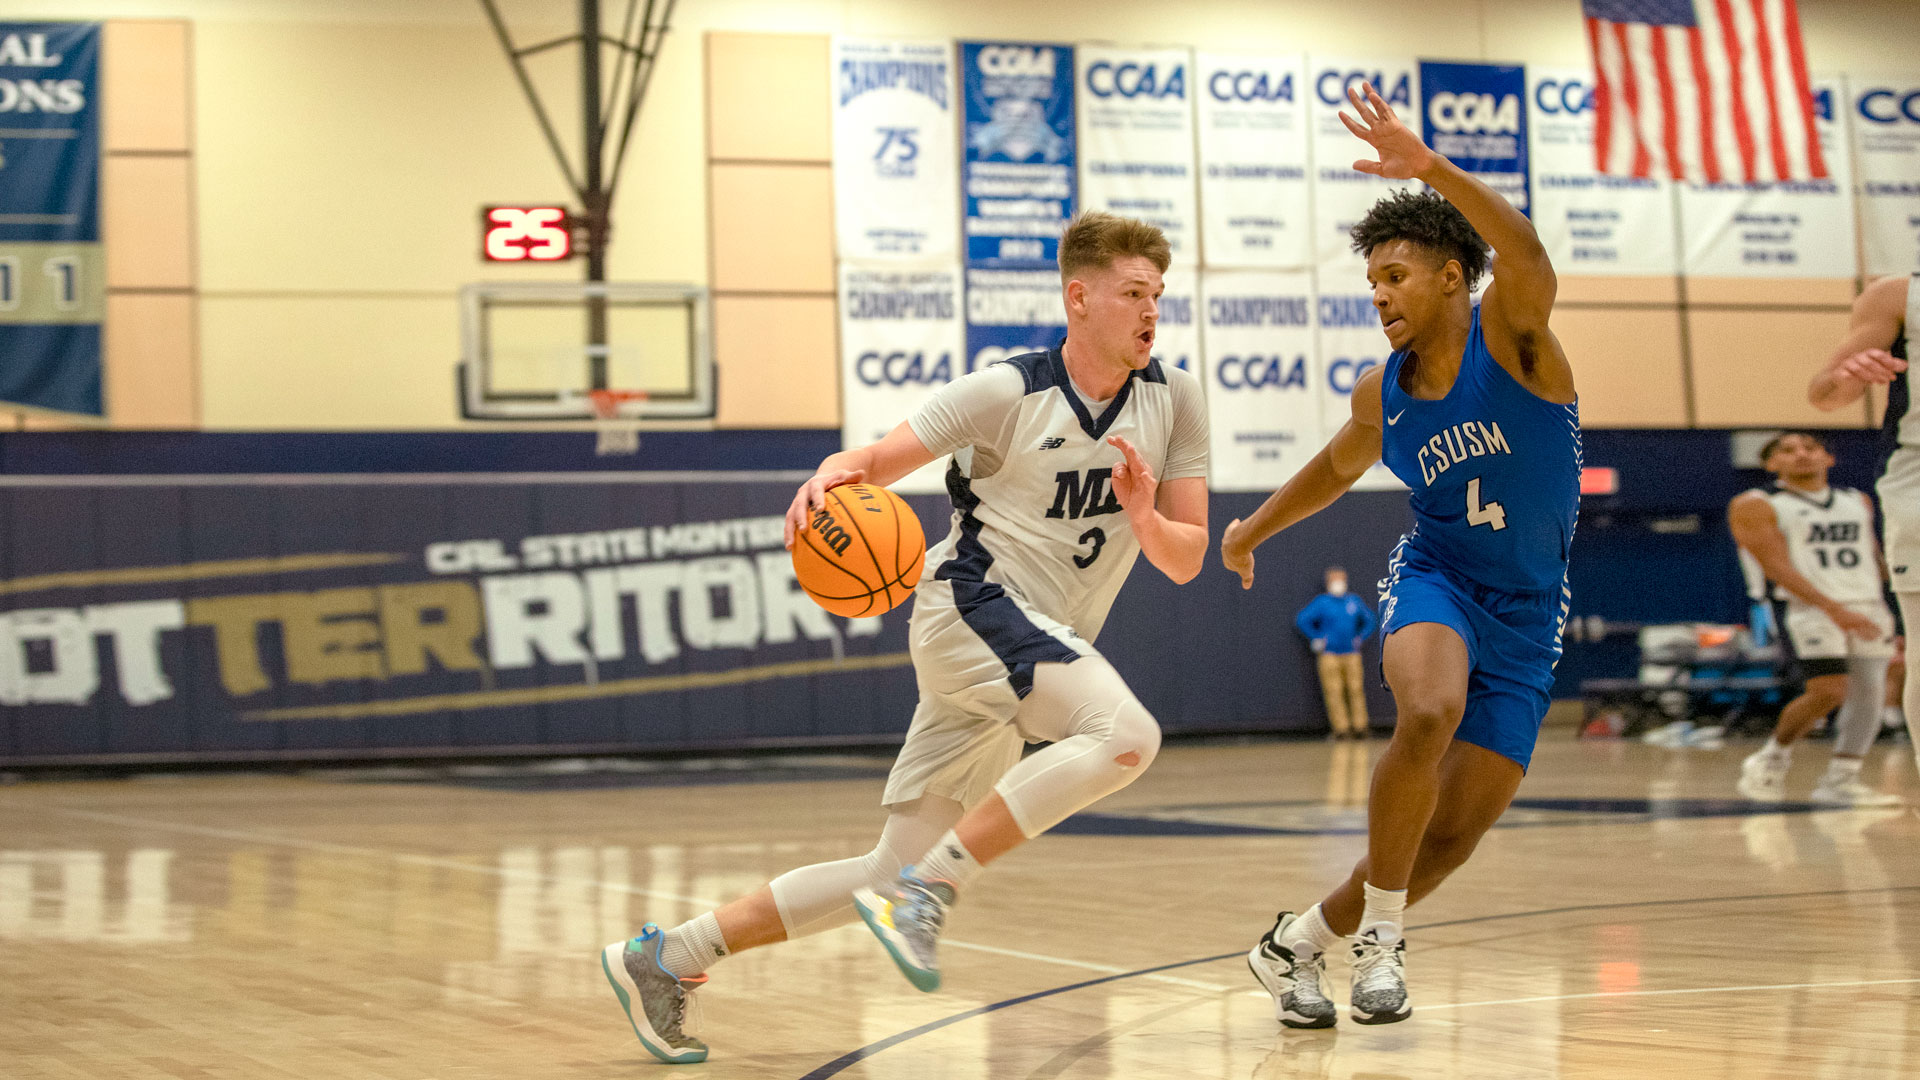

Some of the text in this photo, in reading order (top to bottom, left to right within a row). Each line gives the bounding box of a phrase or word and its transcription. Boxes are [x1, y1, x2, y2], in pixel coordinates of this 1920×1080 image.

[1086, 61, 1186, 100] CCAA
[1208, 70, 1294, 103] CCAA
[1428, 91, 1520, 136] CCAA
[873, 127, 920, 162] 75
[486, 207, 571, 261] 25
[1210, 297, 1309, 327] CHAMPIONS
[857, 352, 954, 387] CCAA
[1217, 355, 1306, 389] CCAA
[1417, 420, 1512, 487] CSUSM
[1465, 477, 1507, 531] 4
[425, 540, 517, 574] CAL
[521, 527, 650, 567] STATE
[1072, 527, 1106, 569] 3
[1815, 547, 1859, 568] 10
